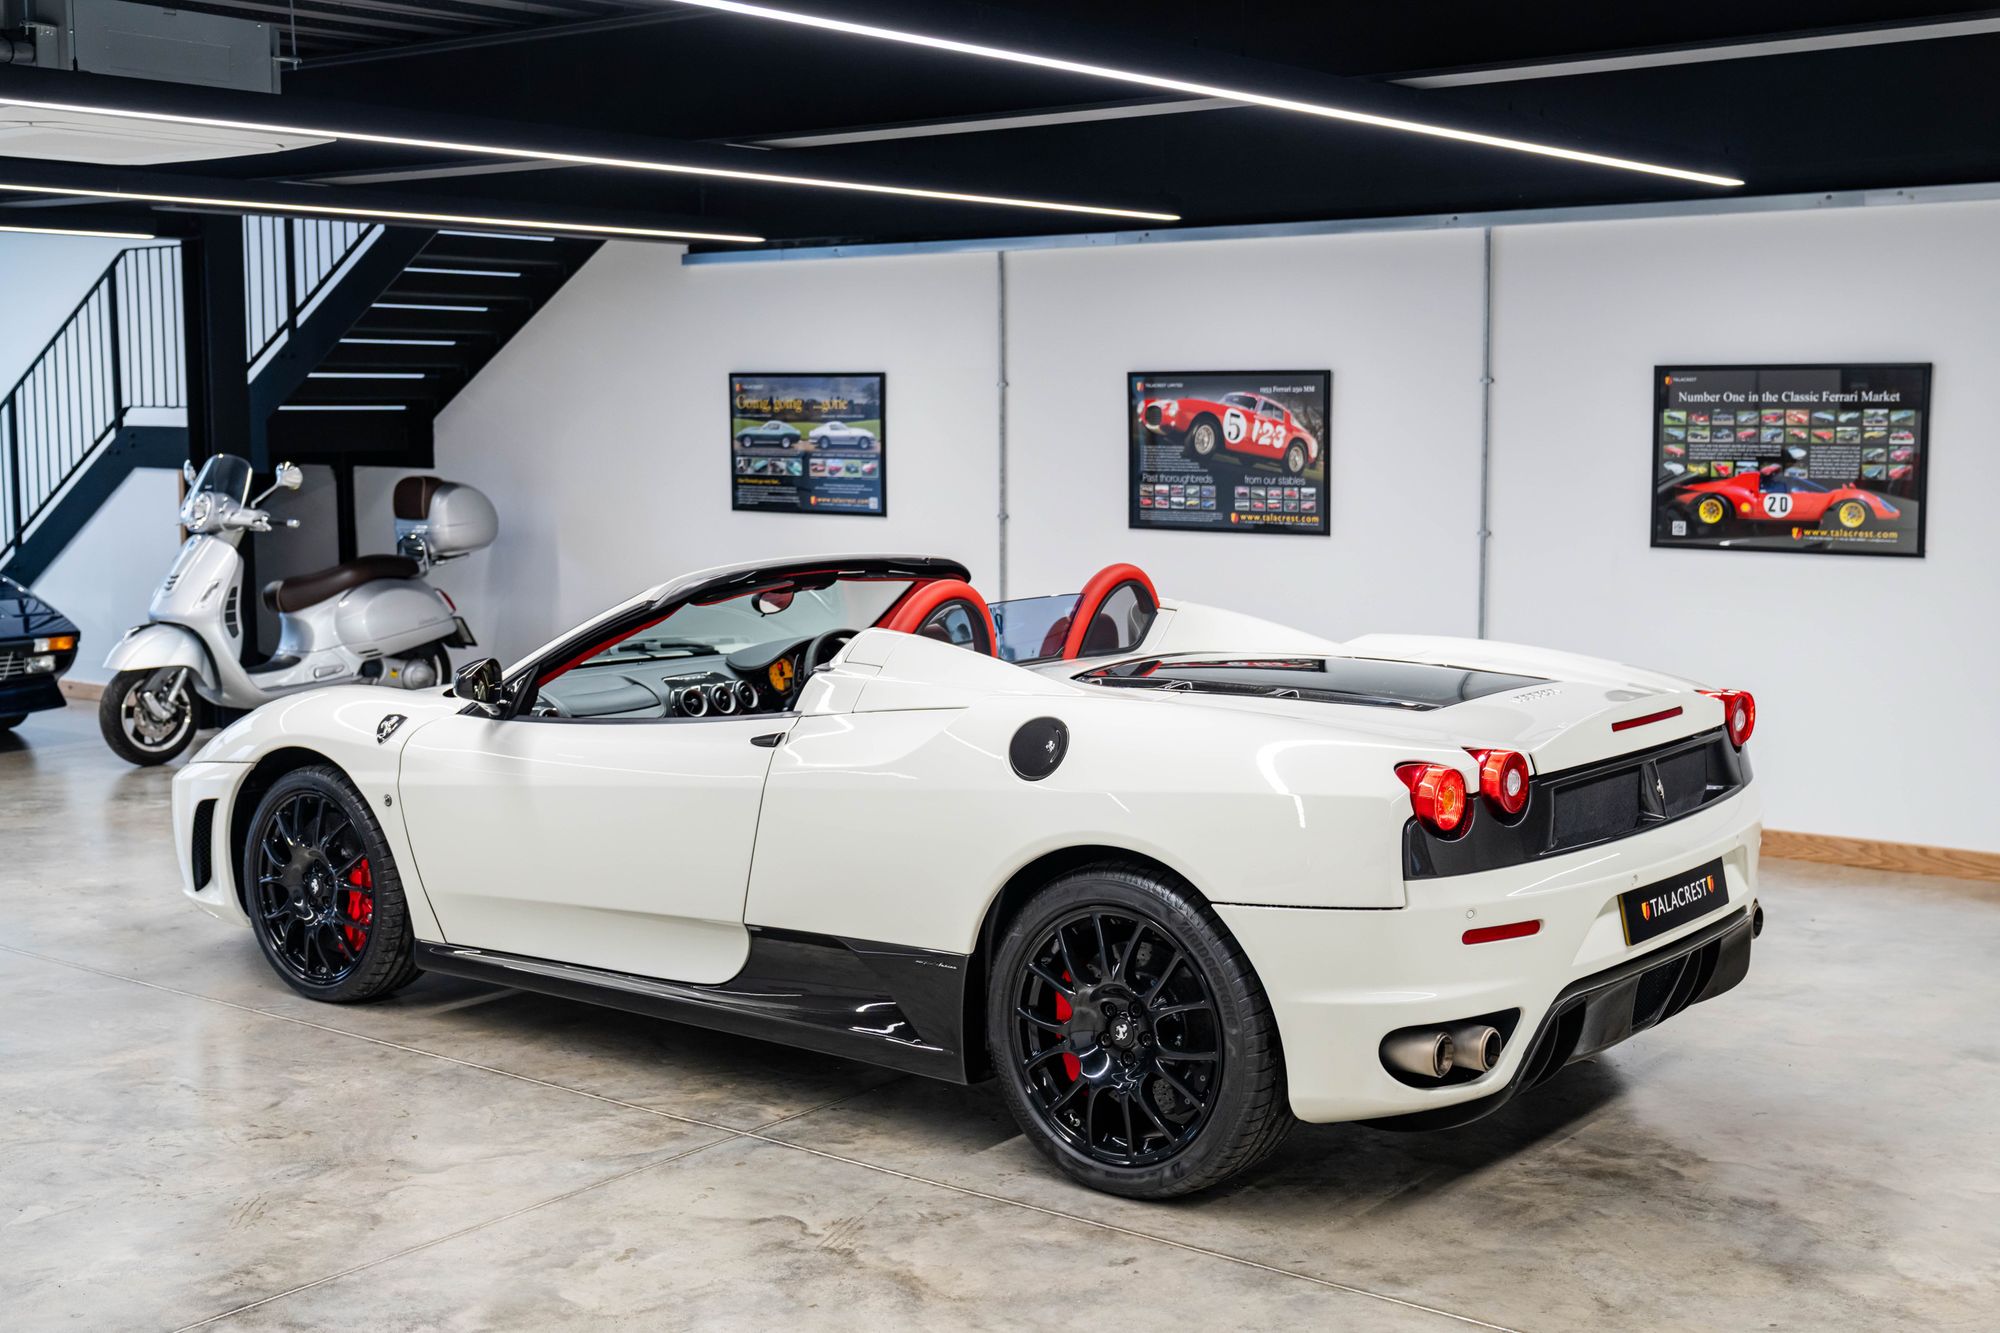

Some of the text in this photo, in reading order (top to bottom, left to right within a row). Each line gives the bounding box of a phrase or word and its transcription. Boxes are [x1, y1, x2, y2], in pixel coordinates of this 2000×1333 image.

[1273, 385, 1291, 393] Ferrari
[1303, 385, 1316, 393] MM
[1678, 391, 1900, 402] Number One in the Classic Ferrari Market
[773, 396, 803, 413] going
[1228, 412, 1241, 441] 5
[1142, 473, 1214, 485] Past thoroughbreds
[1244, 475, 1306, 486] from our stables
[1768, 496, 1788, 513] 20
[1240, 514, 1320, 524] www.talacrest.com
[1803, 528, 1899, 539] www.talacrest.com
[1649, 878, 1707, 917] TALACREST
